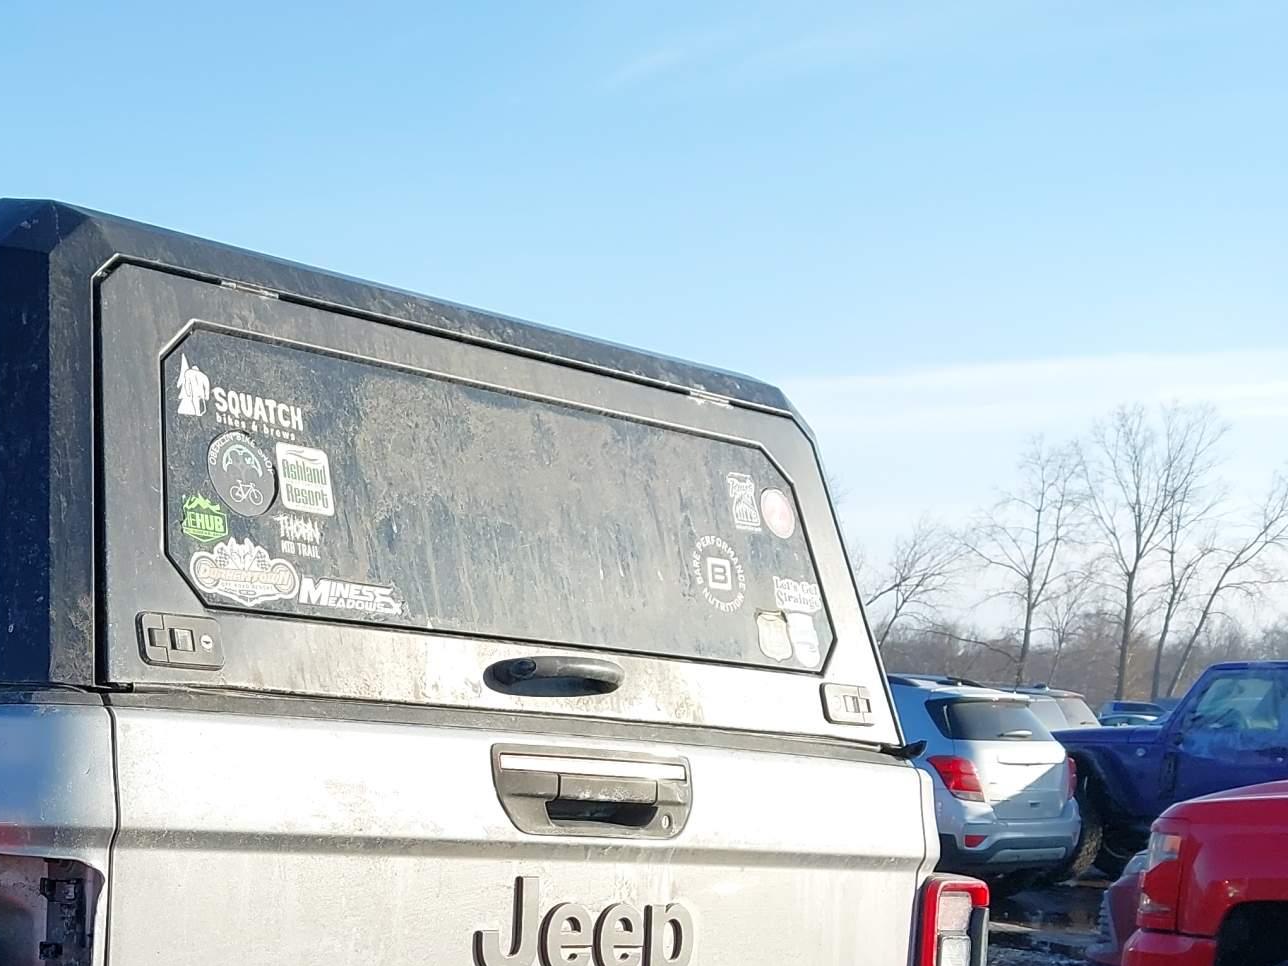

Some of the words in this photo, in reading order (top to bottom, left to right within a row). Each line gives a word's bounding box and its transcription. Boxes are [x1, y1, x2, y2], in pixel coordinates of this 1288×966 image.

[213, 387, 304, 431] SQUATCH
[263, 423, 295, 440] brews
[210, 432, 234, 466] OBERLIN
[282, 459, 327, 486] Ashland
[285, 483, 329, 509] Resort
[297, 542, 321, 559] TRAIL
[692, 551, 704, 585] BARE
[702, 588, 745, 612] NUTRITION
